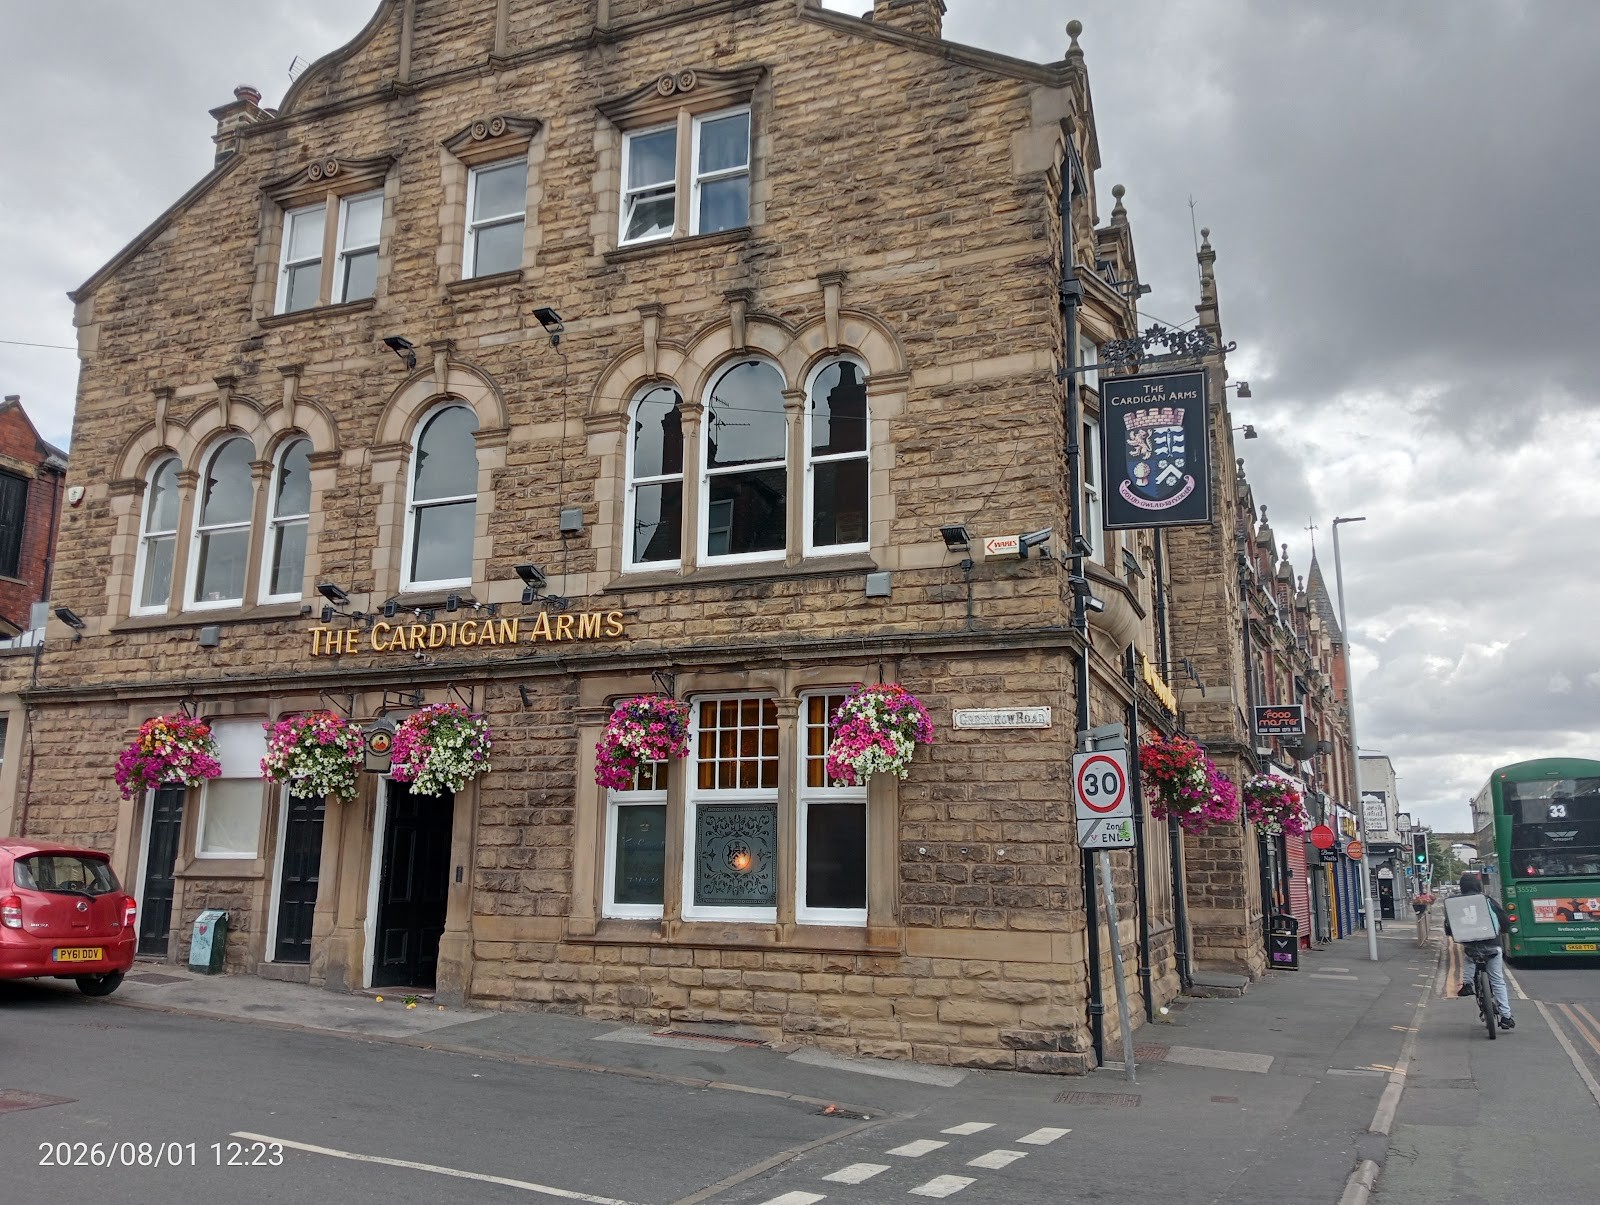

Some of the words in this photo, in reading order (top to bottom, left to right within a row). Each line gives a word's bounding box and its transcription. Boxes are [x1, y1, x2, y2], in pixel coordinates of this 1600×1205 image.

[1143, 385, 1164, 393] THE
[1111, 394, 1166, 406] CARDIGAN
[1169, 391, 1197, 400] ARMS
[308, 626, 359, 656] THE
[371, 617, 518, 652] CARDIGAN
[531, 611, 624, 642] ARMS
[1084, 772, 1117, 796] 30
[1550, 804, 1566, 817] 33
[60, 950, 80, 959] PY61
[82, 949, 98, 958] DDV
